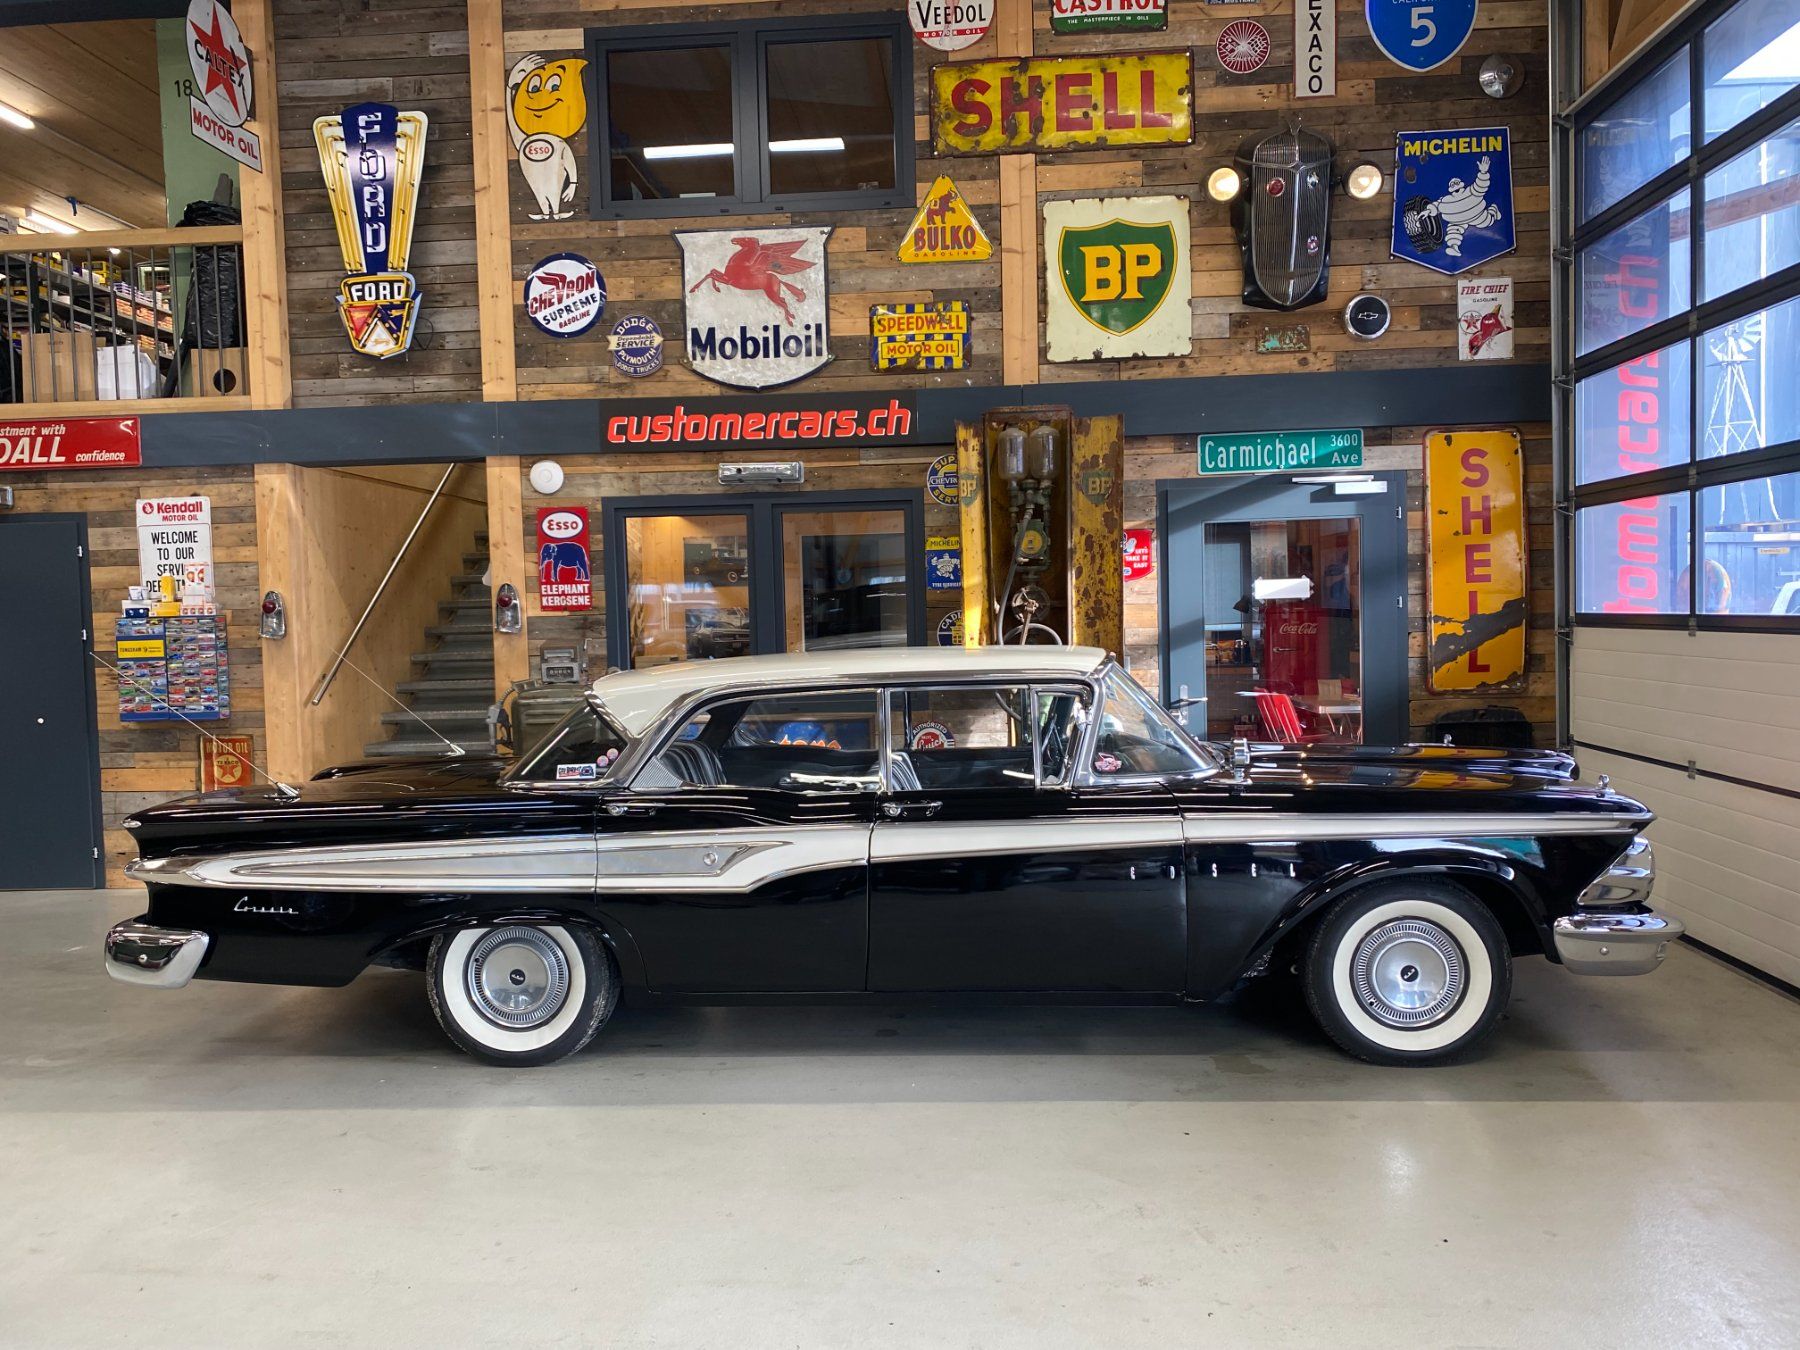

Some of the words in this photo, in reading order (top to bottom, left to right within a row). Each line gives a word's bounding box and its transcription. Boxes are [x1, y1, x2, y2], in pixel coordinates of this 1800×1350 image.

[916, 0, 986, 28] VEEDOL
[1411, 6, 1436, 47] 5
[194, 38, 245, 88] CALTEX
[174, 79, 193, 98] 18
[951, 70, 1173, 137] SHELL
[192, 107, 235, 147] MOTOR
[238, 137, 258, 160] OIL
[1404, 136, 1503, 156] MICHELIN
[358, 112, 387, 253] FORD
[914, 225, 976, 252] BULKO
[1079, 243, 1163, 302] BP
[351, 282, 404, 302] FORD
[529, 270, 596, 315] CHEVRON
[1461, 286, 1481, 295] FIRE
[1484, 285, 1509, 294] CHIEF
[542, 293, 598, 325] SUPREME
[559, 309, 591, 329] GASOLINE
[617, 318, 654, 335] DODGE
[878, 314, 963, 333] SPEEDWELL
[616, 340, 655, 348] SERVICE
[691, 323, 823, 361] Mobiloil
[887, 345, 931, 355] MOTOR
[935, 343, 956, 353] OIL
[618, 348, 657, 365] PLYMOUTH
[41, 424, 66, 435] with
[607, 399, 911, 443] customercars.ch
[76, 450, 125, 462] confidence
[1205, 437, 1316, 469] Carmichael
[1330, 434, 1358, 447] 3600
[1331, 452, 1359, 464] Ave
[934, 456, 955, 470] SUP
[933, 489, 958, 503] SERV
[960, 480, 977, 497] BP
[157, 501, 203, 514] Kendall
[151, 531, 198, 545] WELCOME
[157, 548, 169, 560] TO
[175, 547, 194, 560] OUR
[157, 563, 184, 577] SERVI
[541, 584, 590, 595] ELEPHANT
[542, 595, 591, 606] KEROSENE
[913, 721, 948, 735] AUTHORIZED
[206, 742, 233, 753] MOTOR
[235, 742, 248, 753] OIL
